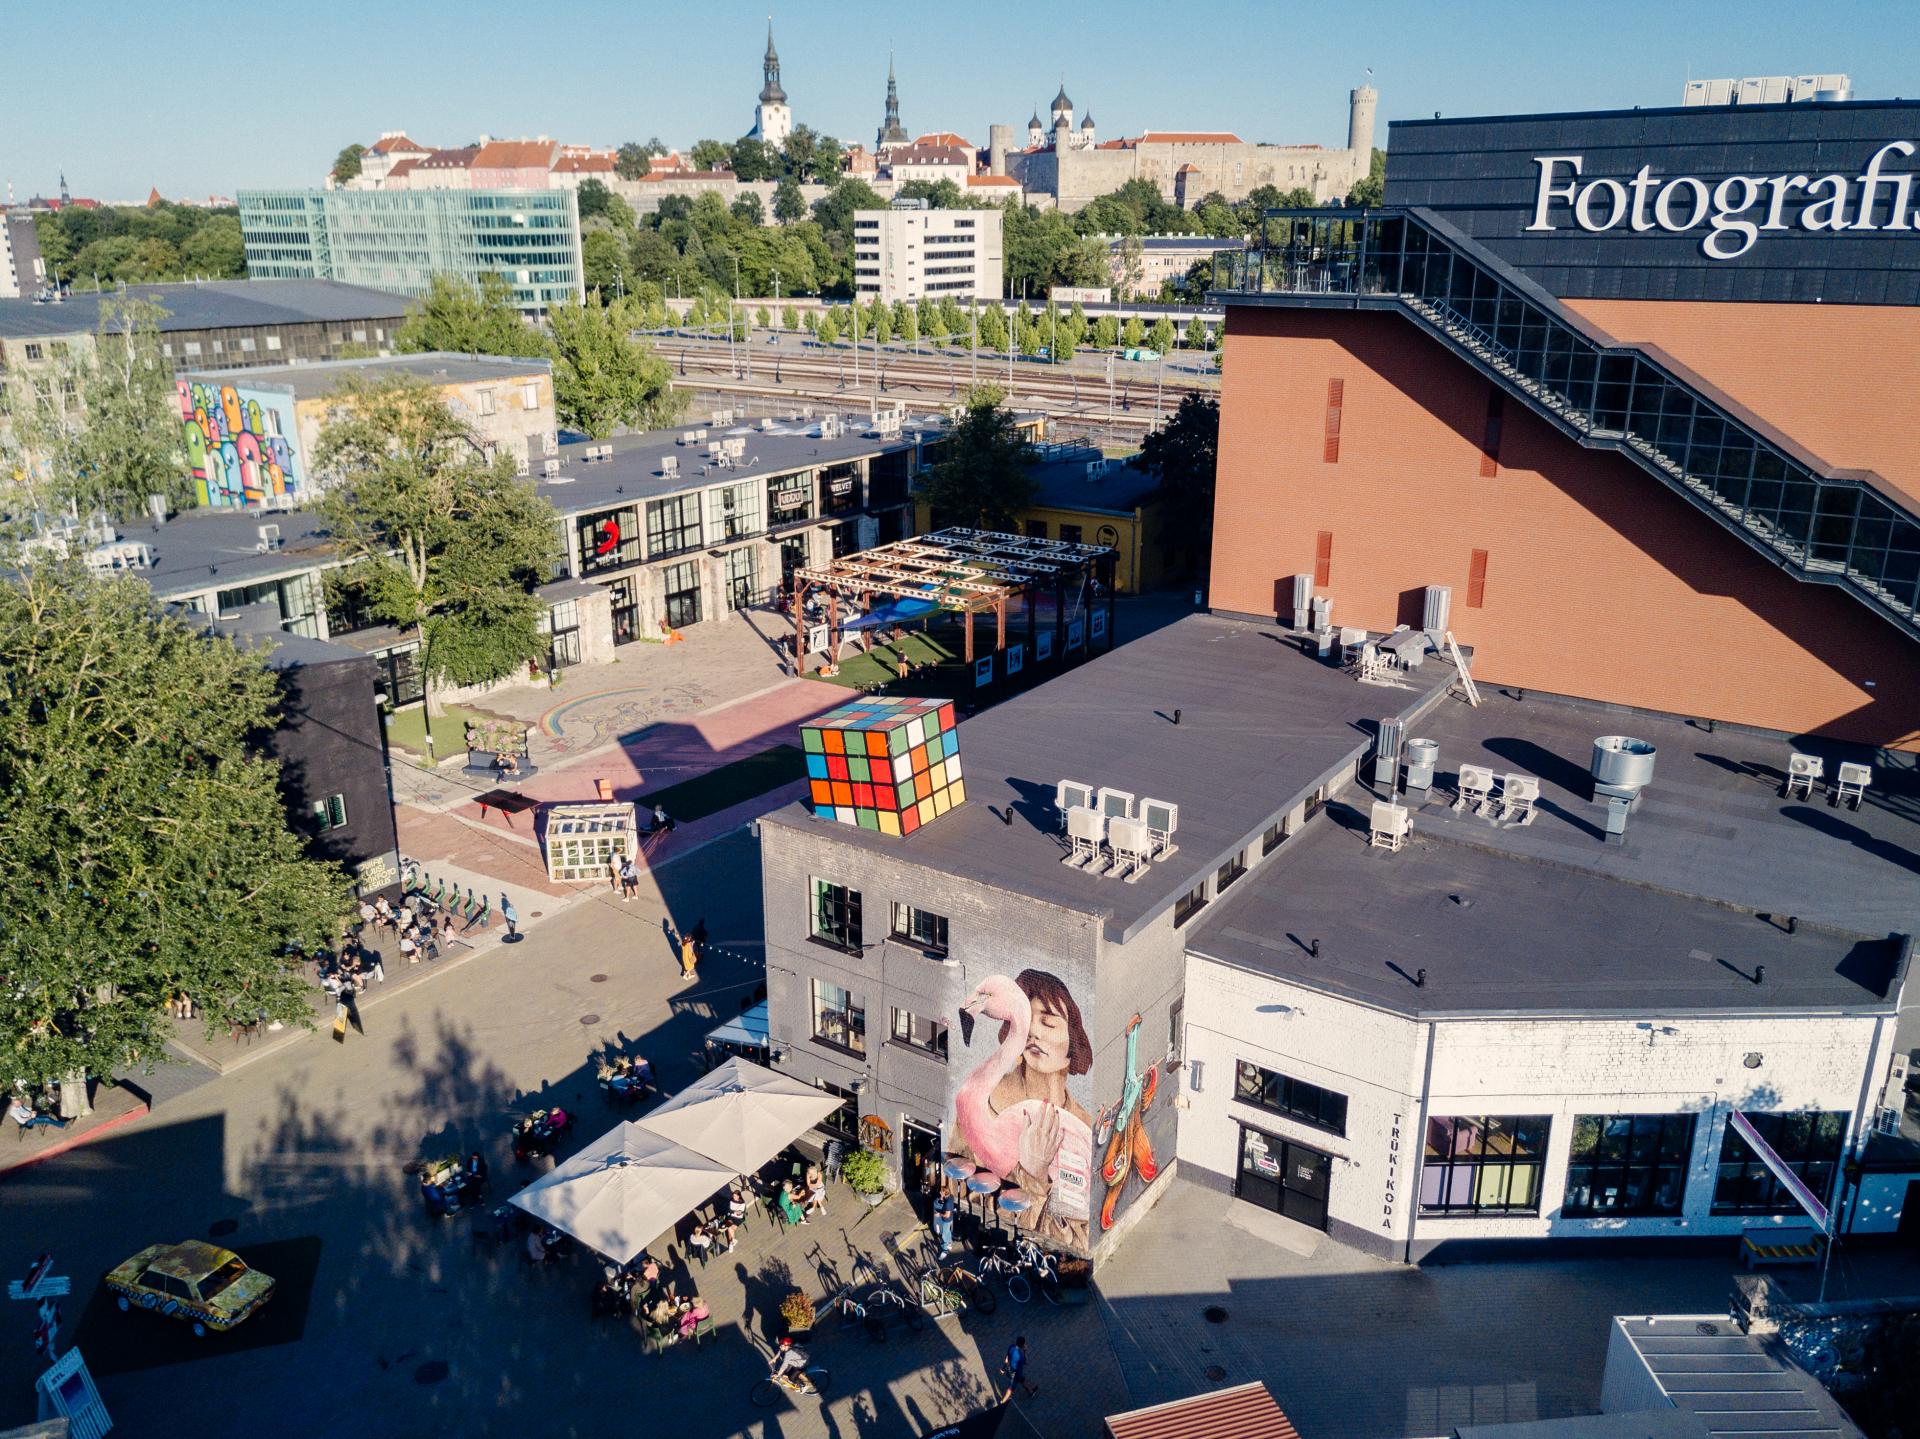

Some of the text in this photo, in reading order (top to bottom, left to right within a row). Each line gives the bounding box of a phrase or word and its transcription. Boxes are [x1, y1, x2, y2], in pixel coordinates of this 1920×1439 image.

[1525, 141, 1920, 260] Fotografi
[830, 480, 853, 492] VELVET
[1382, 1113, 1401, 1229] TRÜKIKODA
